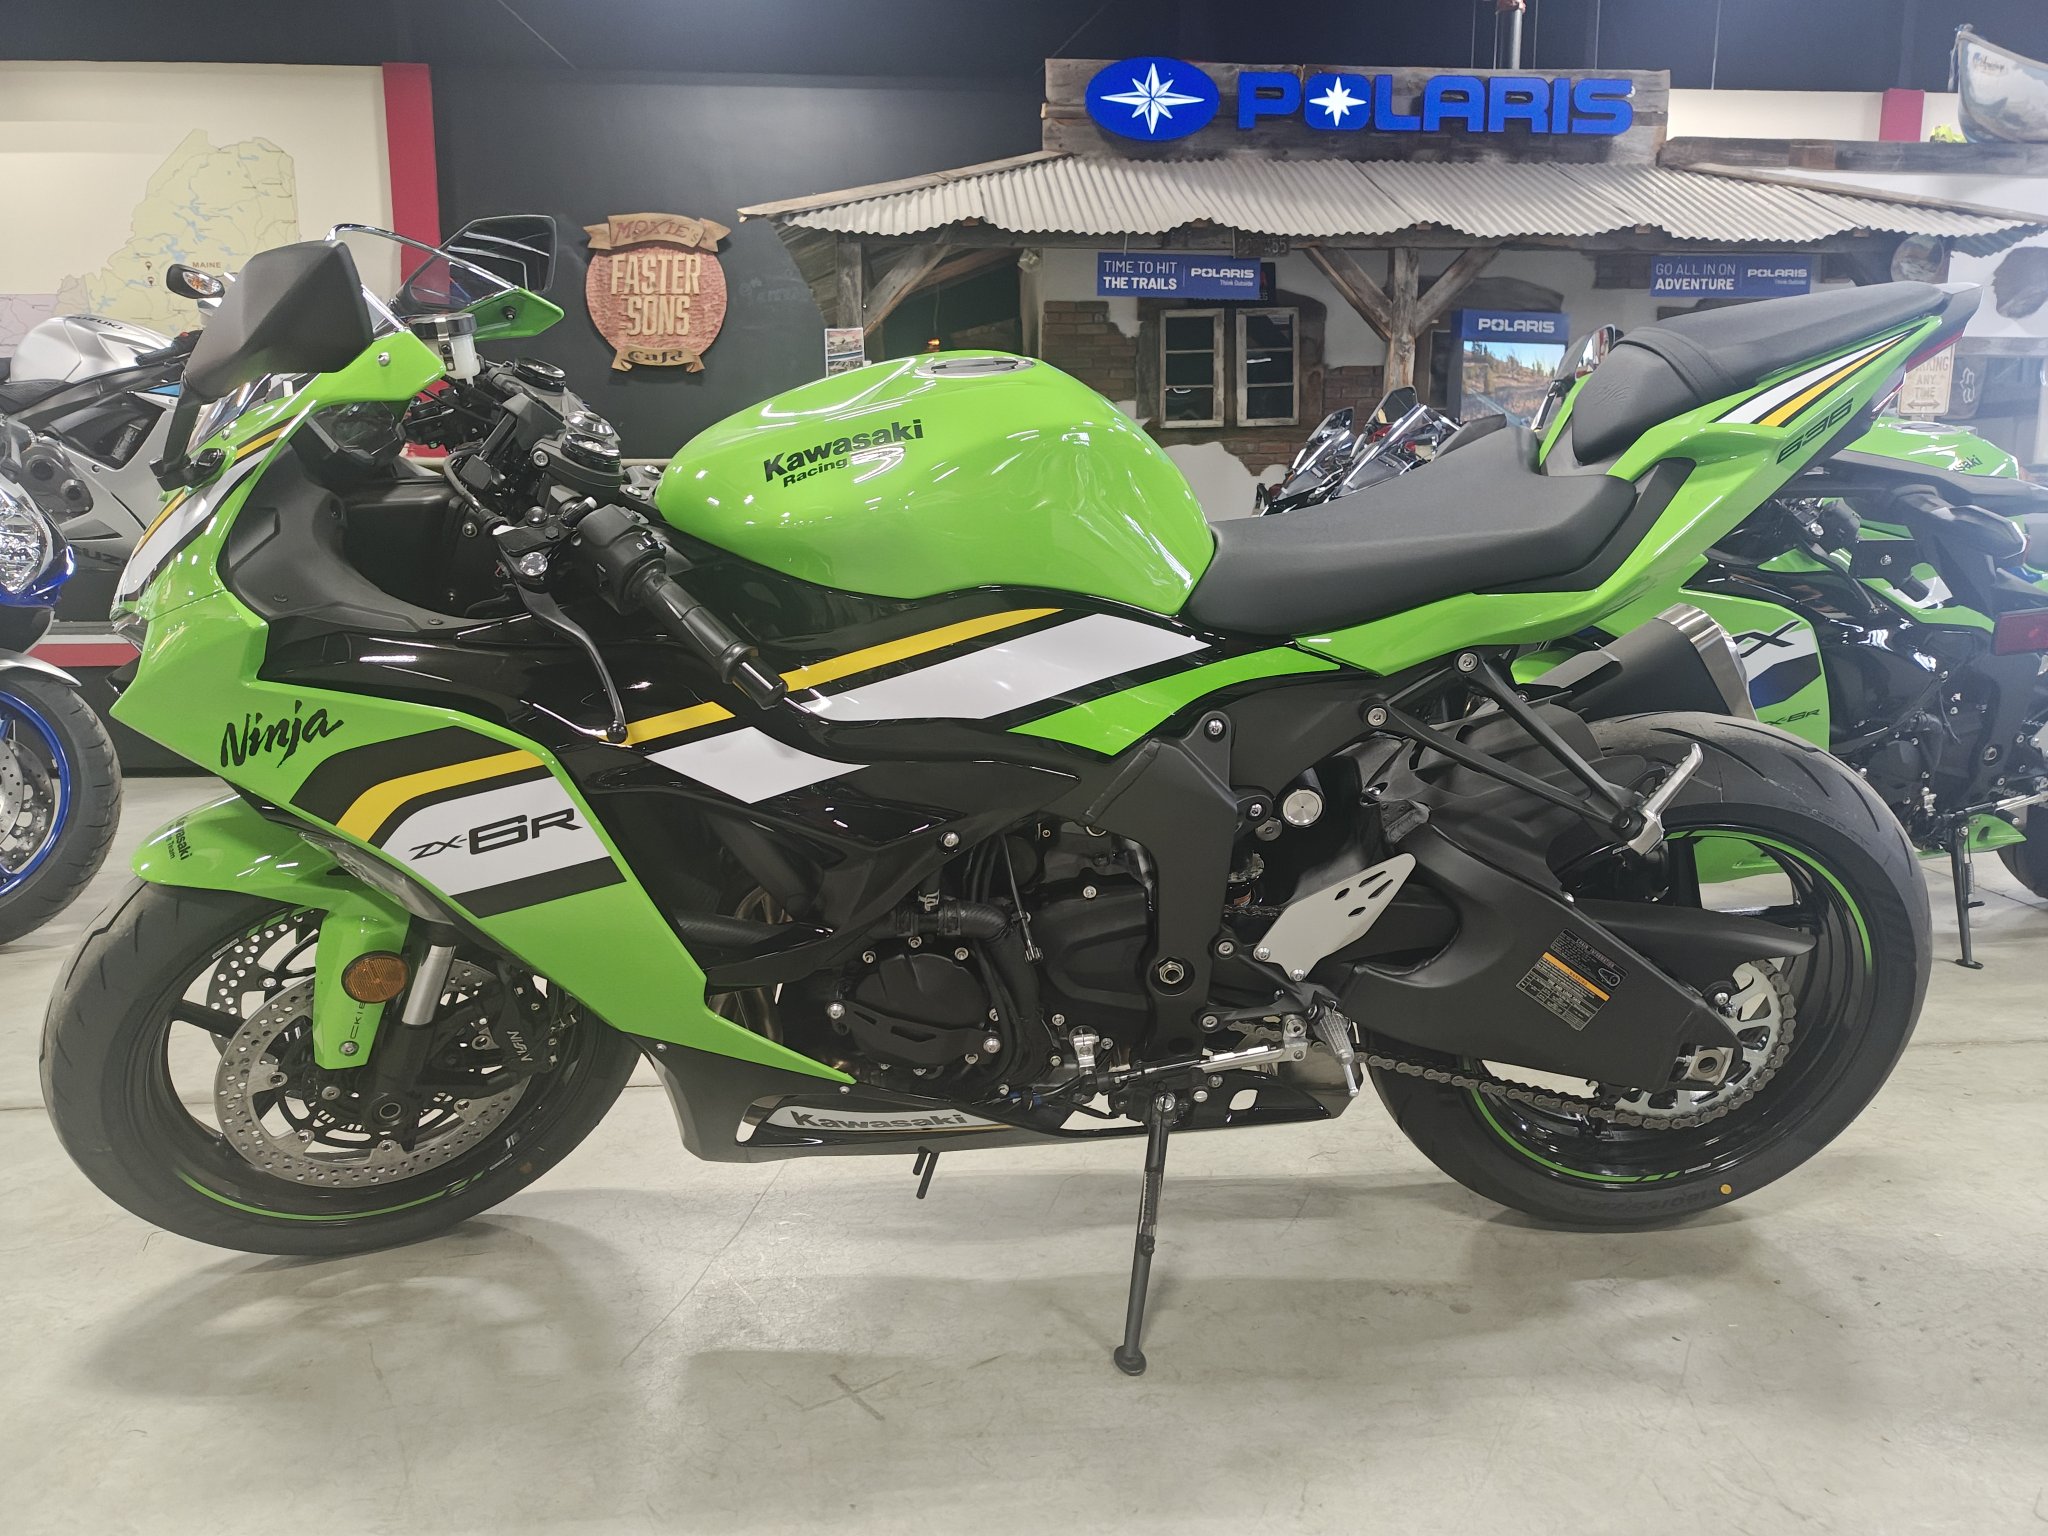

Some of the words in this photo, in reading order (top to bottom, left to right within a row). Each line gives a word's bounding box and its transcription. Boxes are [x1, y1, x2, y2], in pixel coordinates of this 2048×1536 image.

[1238, 72, 1633, 135] POLARIS
[192, 261, 222, 269] MAINE
[1104, 261, 1134, 274] TIME
[1137, 261, 1152, 274] TO
[1156, 262, 1178, 275] HIT
[1655, 263, 1673, 276] GO
[1676, 264, 1697, 276] ALL
[1703, 264, 1716, 276] IN
[1718, 264, 1736, 276] ON
[1747, 268, 1808, 278] POLARIS
[610, 254, 701, 295] FASTER
[1190, 268, 1255, 279] POLARIS
[1103, 276, 1129, 290] THE
[1131, 277, 1178, 291] TRAILS
[1655, 278, 1735, 291] ADVENTURE
[624, 295, 691, 336] SONS
[1478, 318, 1555, 334] POLARIS
[1916, 374, 1935, 386] ANY
[1914, 387, 1936, 398] TIME
[1776, 397, 1854, 465] 636
[763, 418, 924, 483] Kawasaki
[783, 457, 849, 488] Racing
[220, 699, 344, 768] Ninja
[409, 808, 583, 861] ZX-6R
[790, 1110, 966, 1130] Kawasaki
